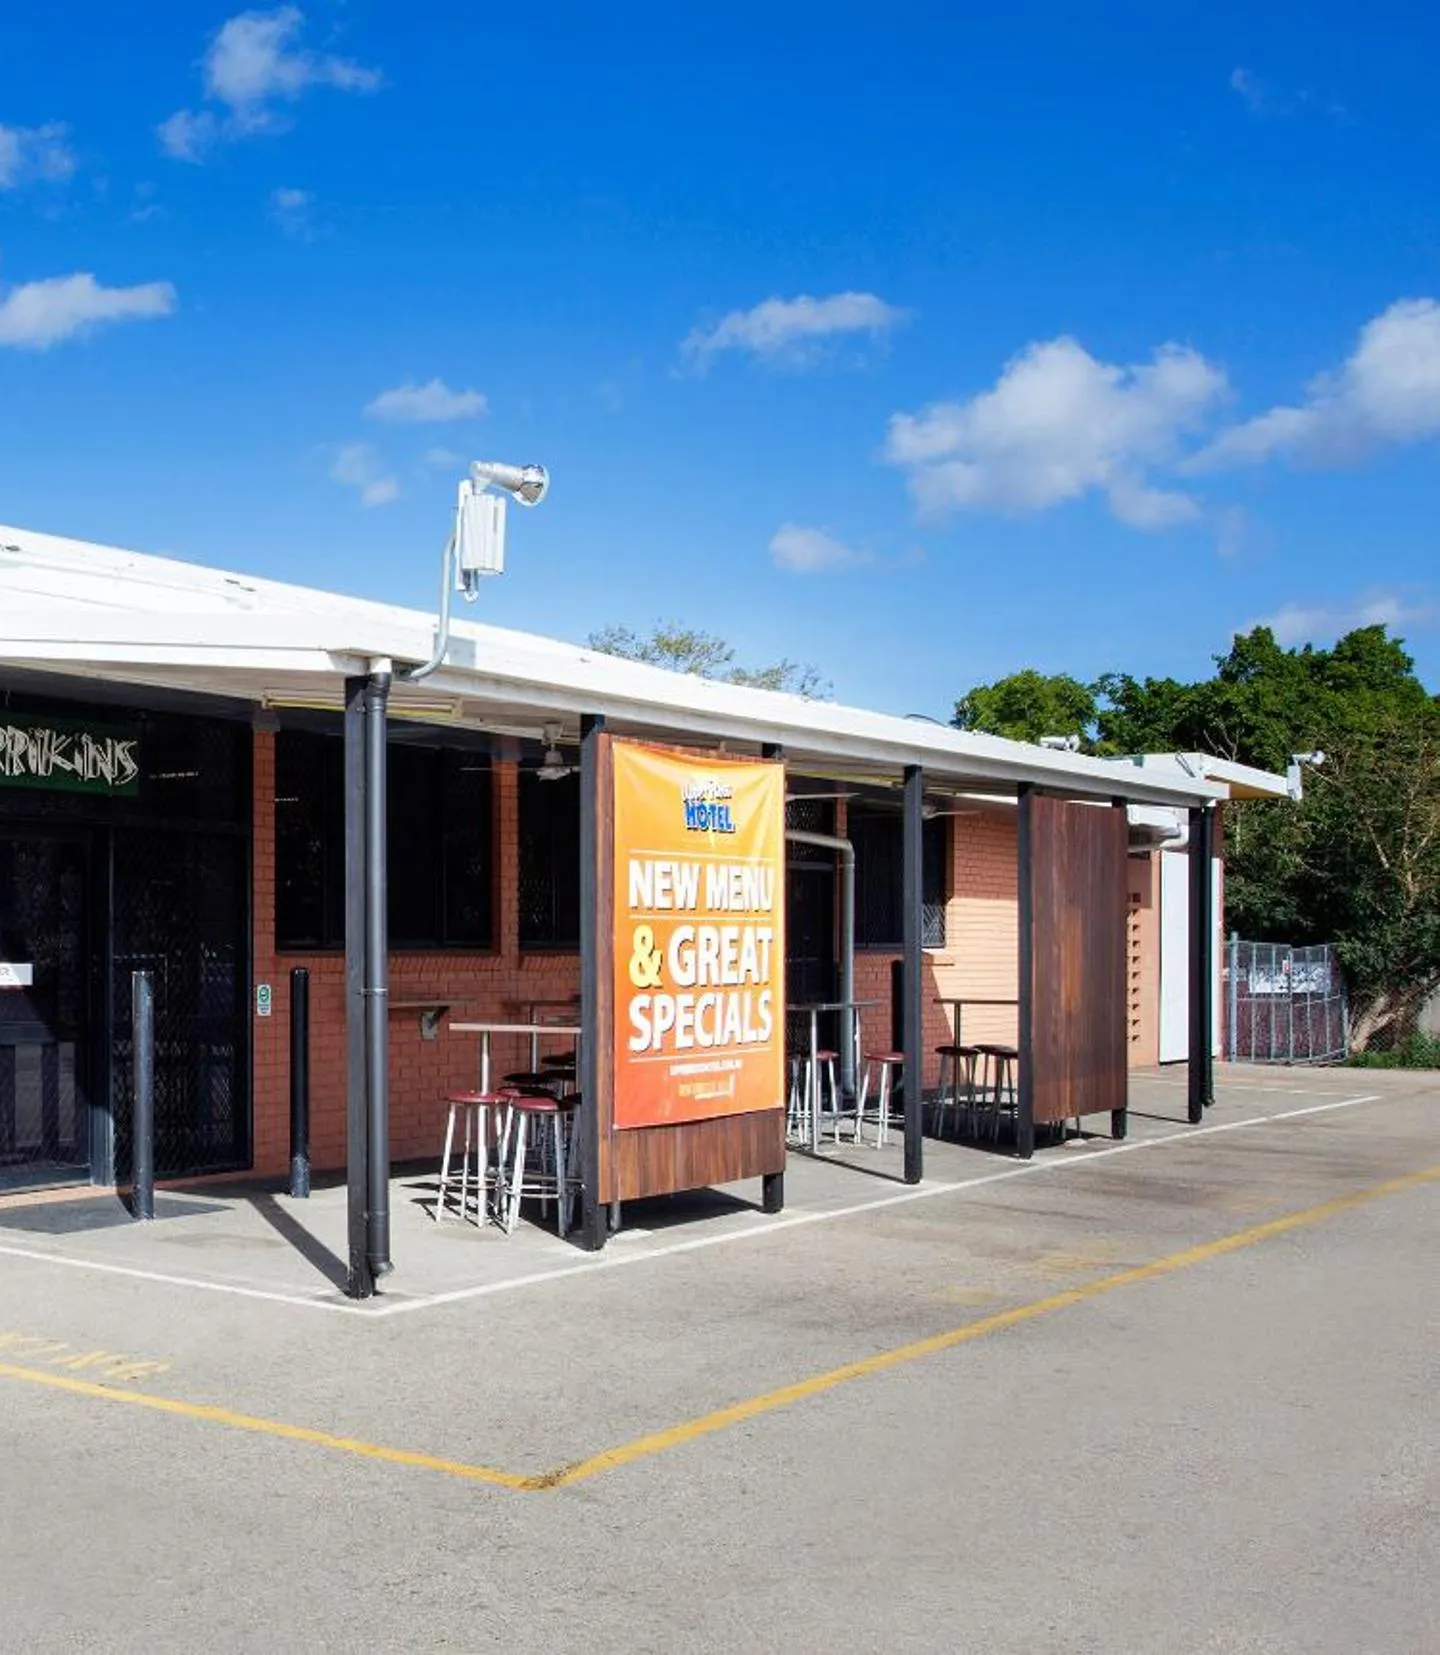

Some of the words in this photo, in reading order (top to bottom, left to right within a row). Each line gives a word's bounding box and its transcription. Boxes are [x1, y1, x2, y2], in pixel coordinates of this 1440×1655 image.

[686, 802, 736, 834] HOTEL
[628, 859, 700, 911] NEW
[705, 863, 775, 912] MENU
[628, 924, 664, 989] &
[667, 924, 773, 988] GREAT
[628, 989, 773, 1054] SPECIALS
